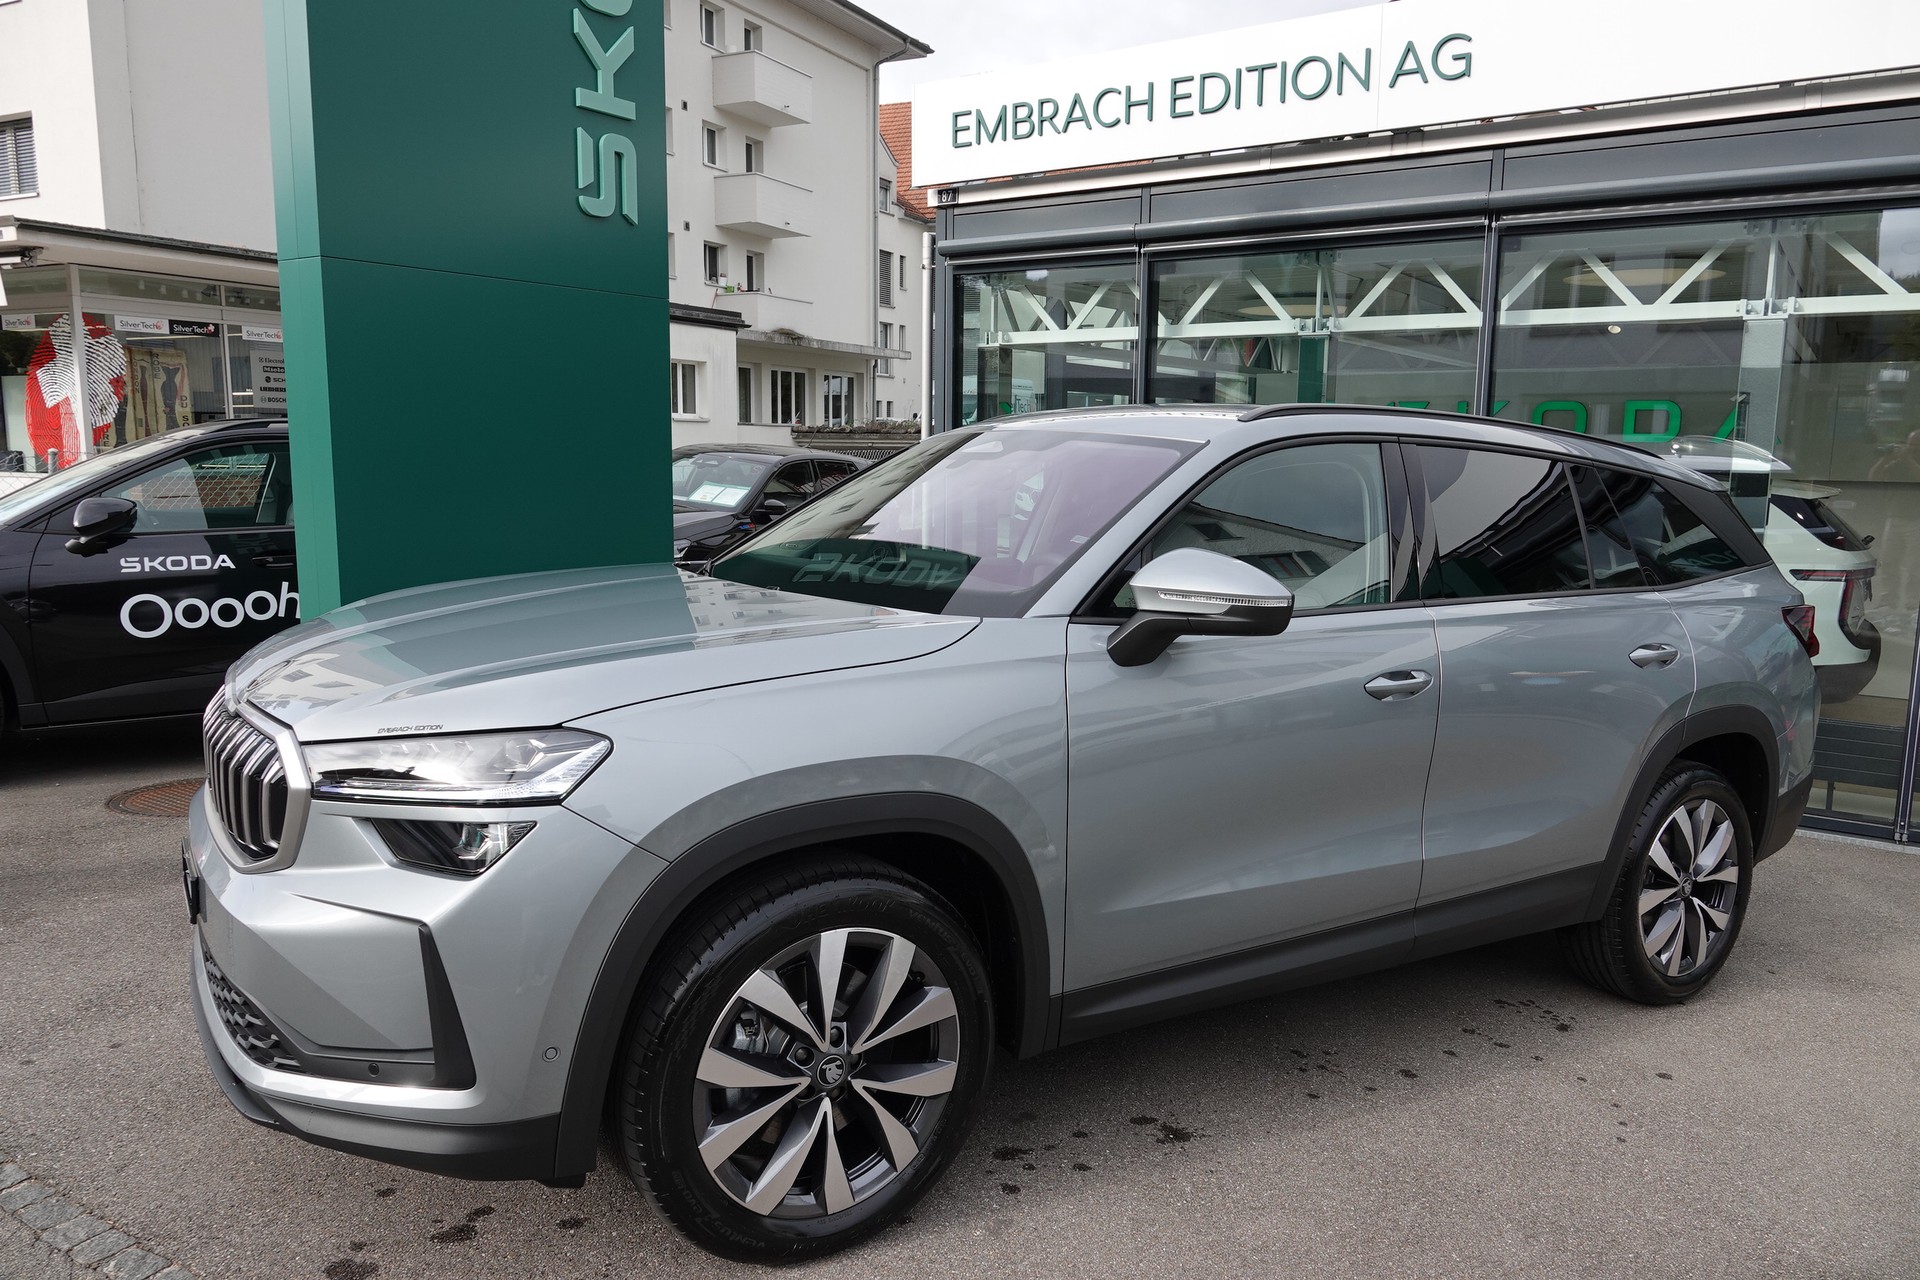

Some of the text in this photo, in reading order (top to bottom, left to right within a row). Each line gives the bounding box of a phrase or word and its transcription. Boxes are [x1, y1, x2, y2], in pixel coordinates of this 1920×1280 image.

[952, 33, 1474, 149] EMBRACH EDITION AG
[573, 0, 638, 225] SK
[941, 190, 953, 202] 87
[119, 319, 159, 331] SilverTech
[173, 323, 208, 334] SilverTech
[120, 554, 236, 573] SKODA
[119, 581, 301, 639] Ooooh
